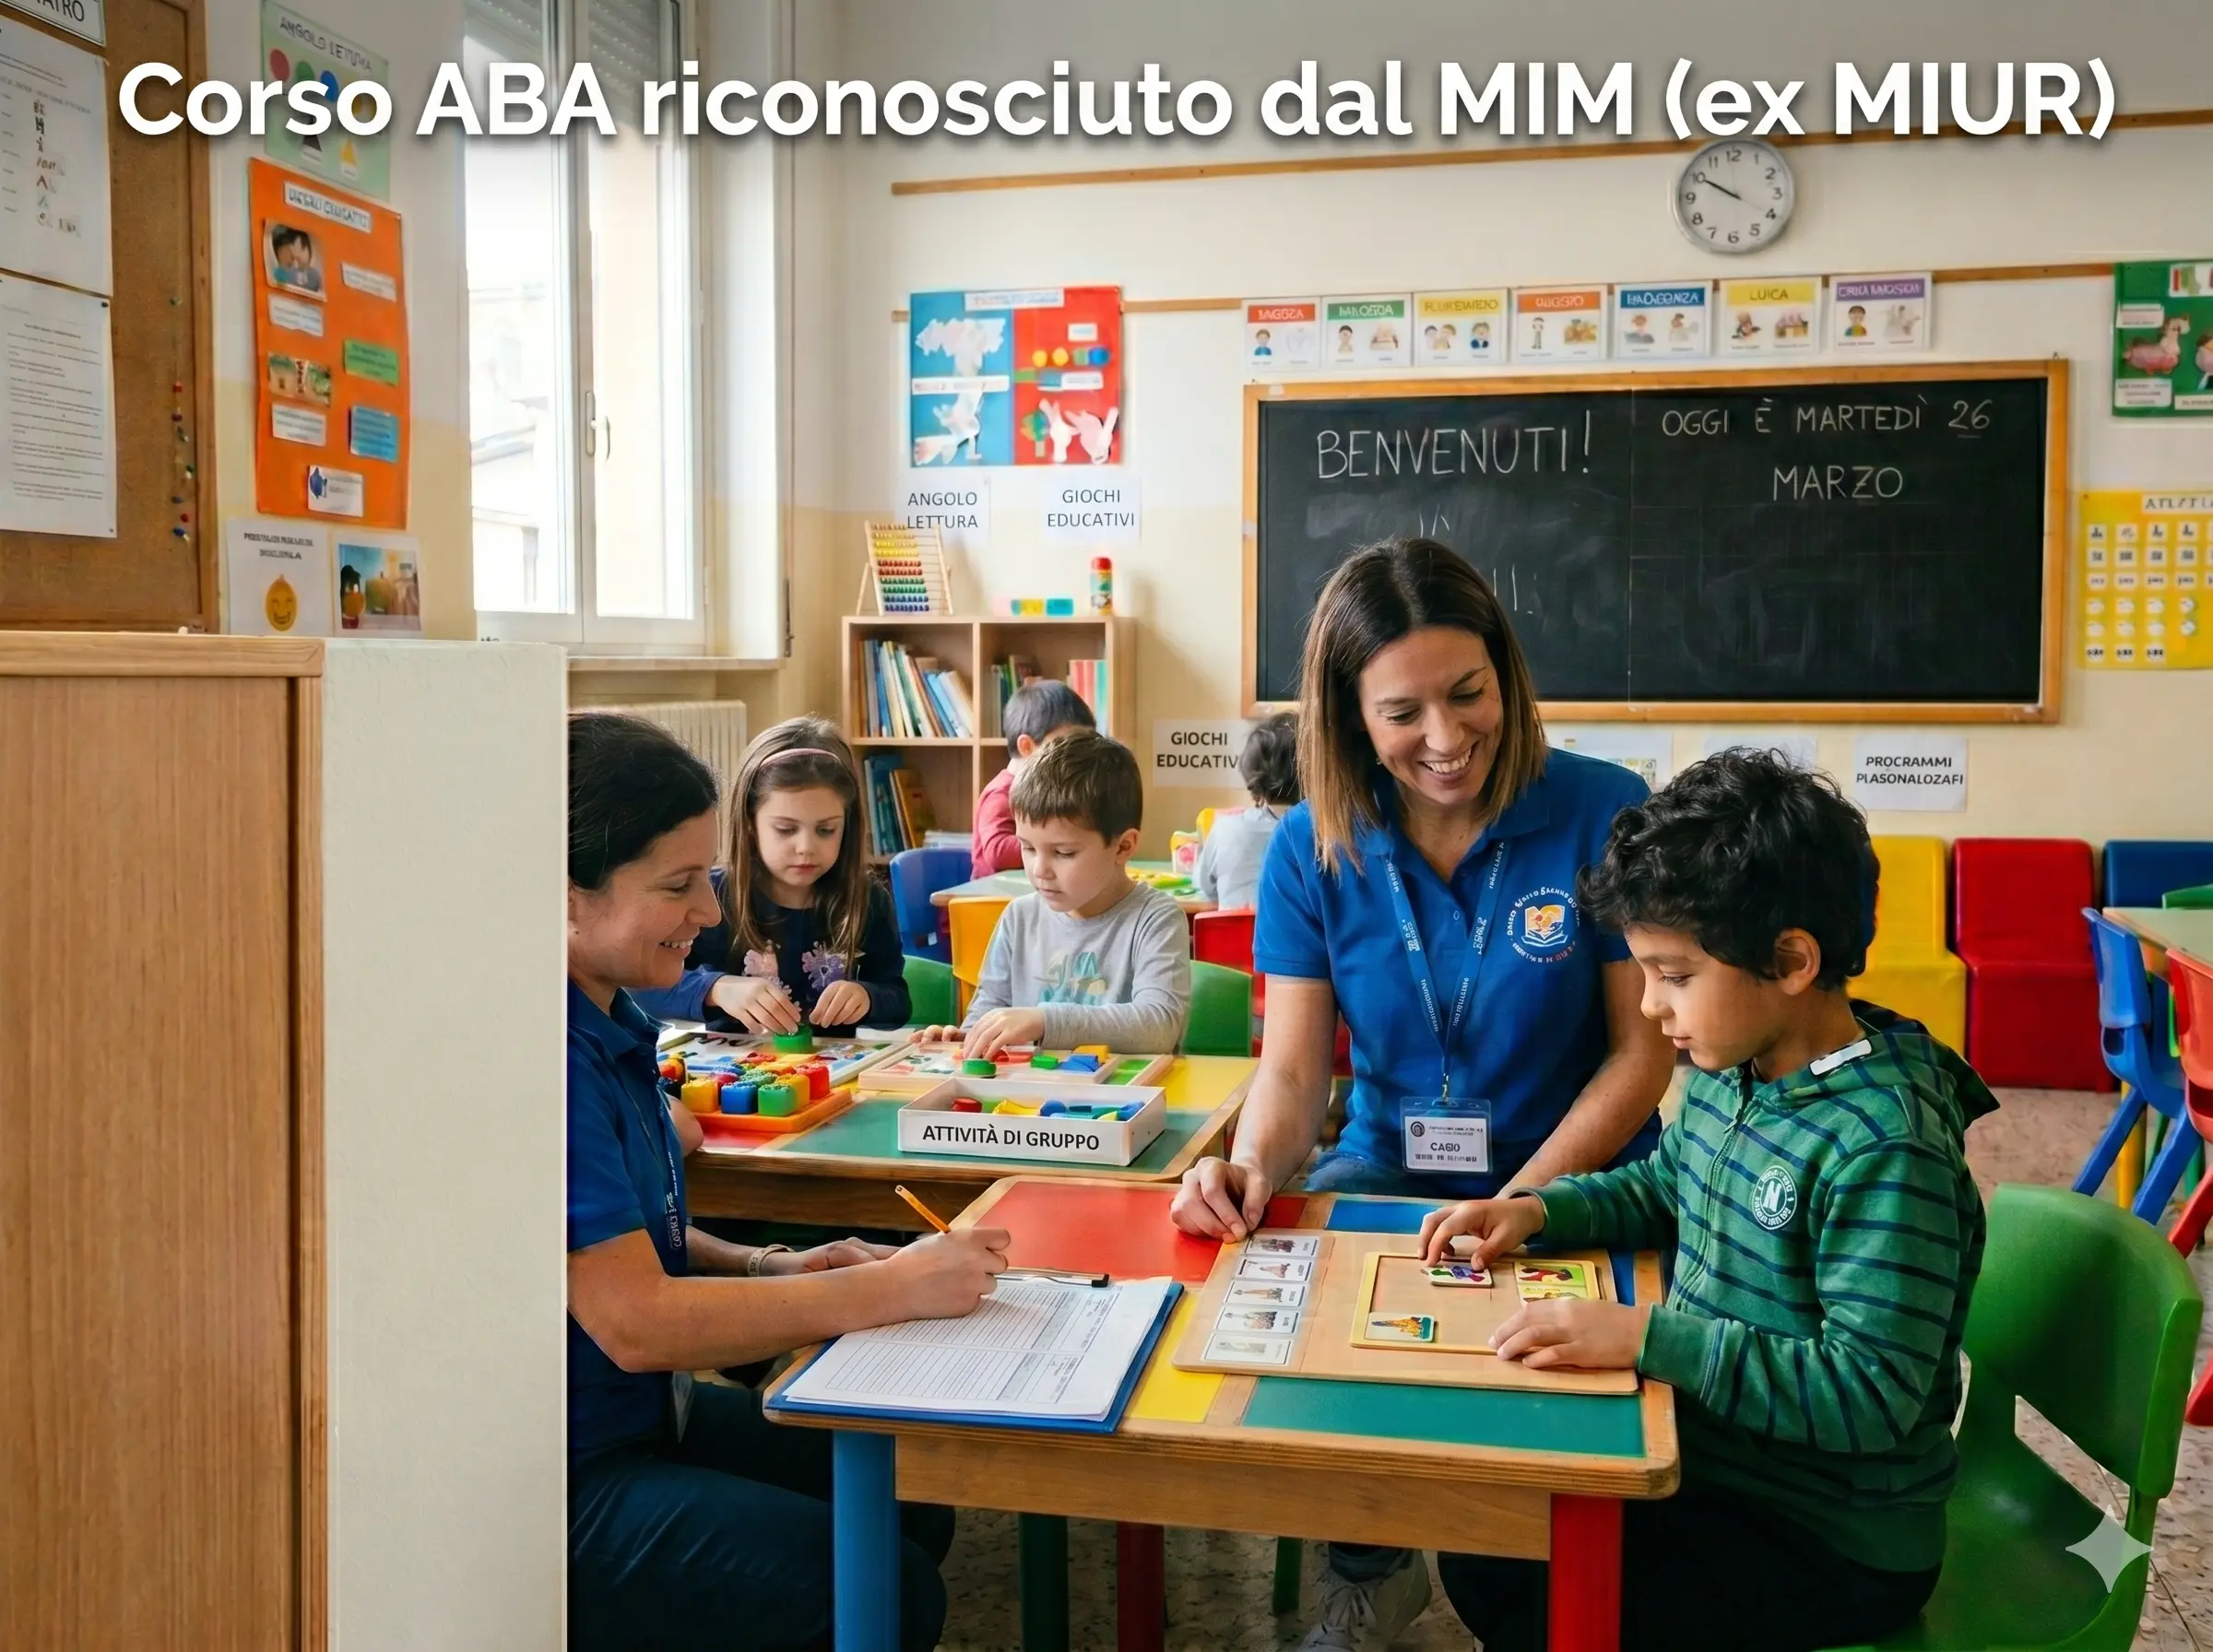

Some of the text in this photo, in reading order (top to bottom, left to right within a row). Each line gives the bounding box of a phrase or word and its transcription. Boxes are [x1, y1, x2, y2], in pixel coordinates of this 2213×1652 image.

[1725, 148, 1742, 162] 12
[1709, 156, 1718, 169] 11
[1691, 171, 1706, 184] 10
[1765, 167, 1776, 180] 2
[1686, 192, 1696, 205] 9
[1772, 187, 1783, 200] 3
[1691, 212, 1703, 225] 8
[1765, 208, 1777, 220] 4
[1707, 227, 1717, 240] 7
[1749, 223, 1760, 237] 5
[1727, 231, 1740, 244] 6
[1662, 394, 1994, 436] OGGI È MARTEDÌ 26
[1317, 409, 1591, 478] BENVENUTI!
[1772, 465, 1904, 502] MARZO
[907, 491, 978, 506] ANGOLO
[1061, 490, 1121, 503] GIOCHI
[906, 514, 978, 529] LETTURA
[1047, 513, 1135, 527] EDUCATIVI
[1170, 731, 1228, 746] GIOCHI
[1156, 754, 1238, 769] EDUCATIV
[922, 1124, 1100, 1150] ATTIVITÀ DI GRUPPO
